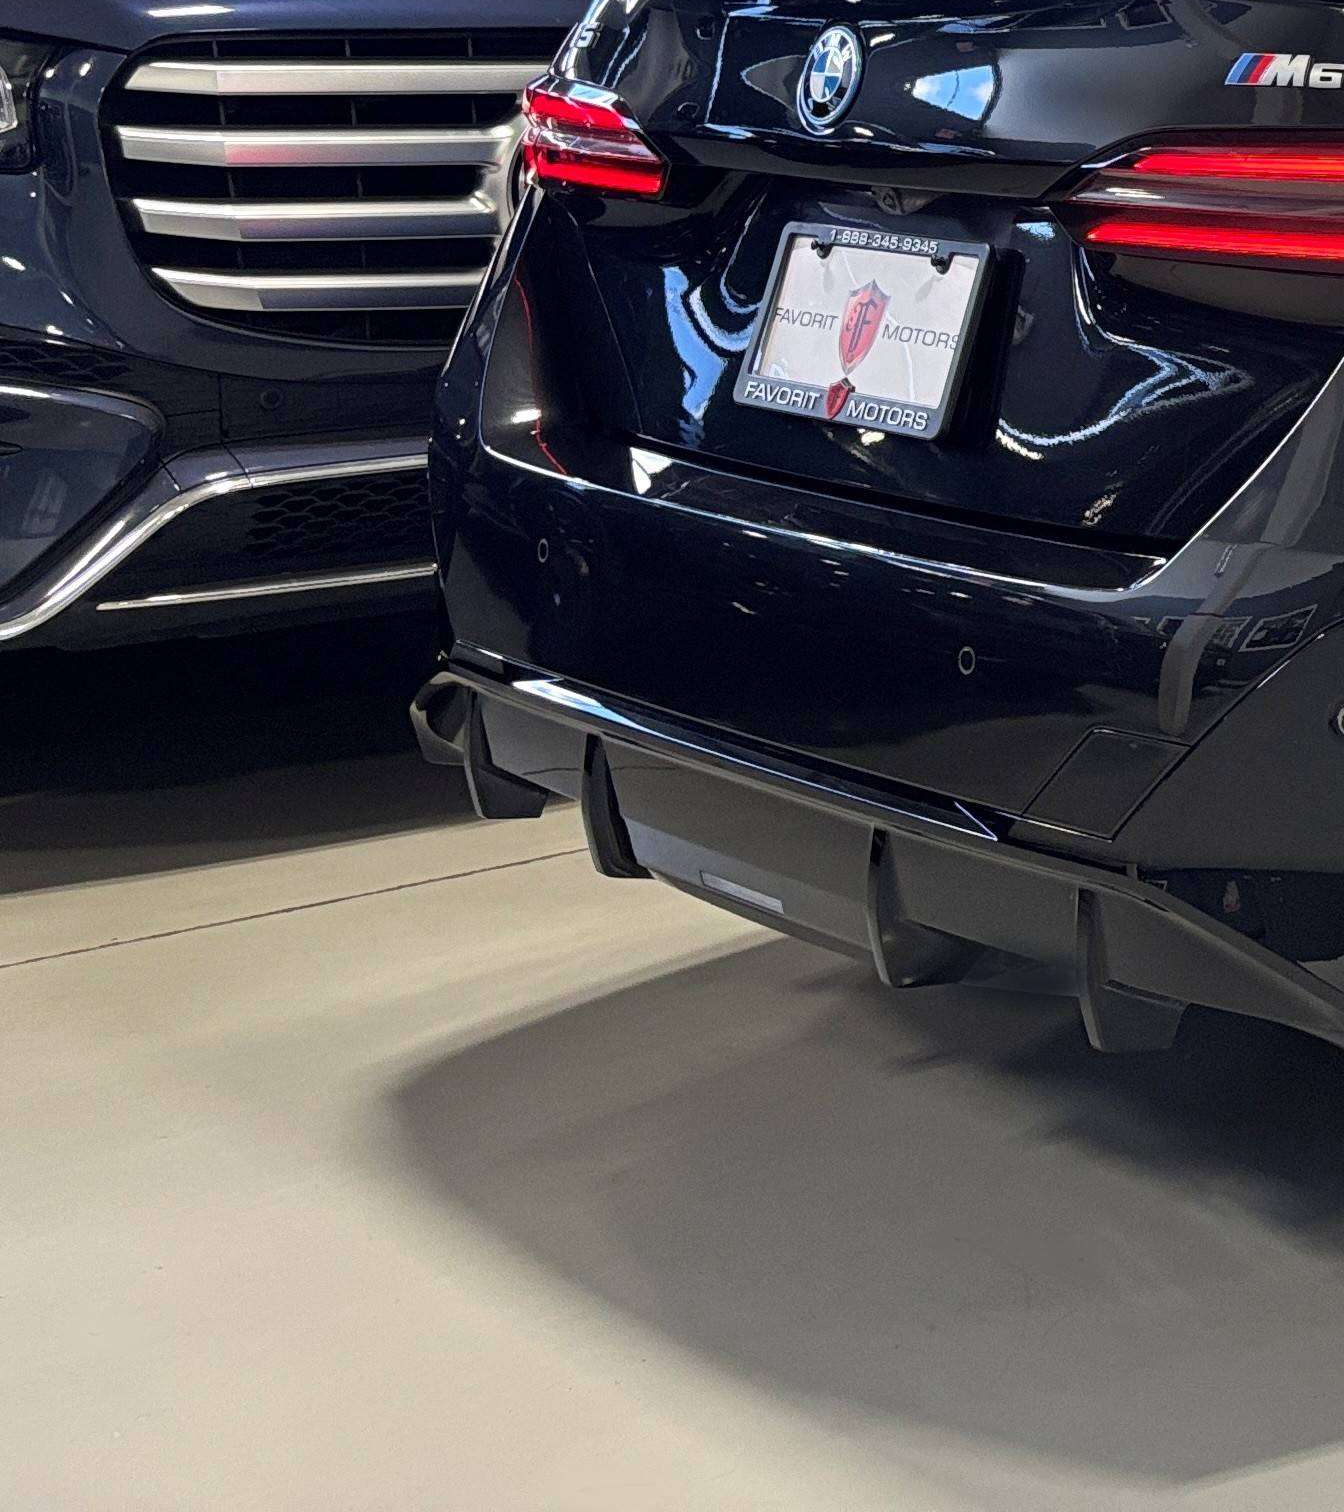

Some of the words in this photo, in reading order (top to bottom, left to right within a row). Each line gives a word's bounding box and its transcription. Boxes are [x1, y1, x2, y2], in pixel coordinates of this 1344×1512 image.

[829, 229, 938, 254] 1-888-345-9345
[775, 307, 839, 331] FAVORIT
[882, 324, 960, 351] MOTORS
[744, 381, 820, 410] FAVORIT
[846, 399, 928, 431] MOTORS
